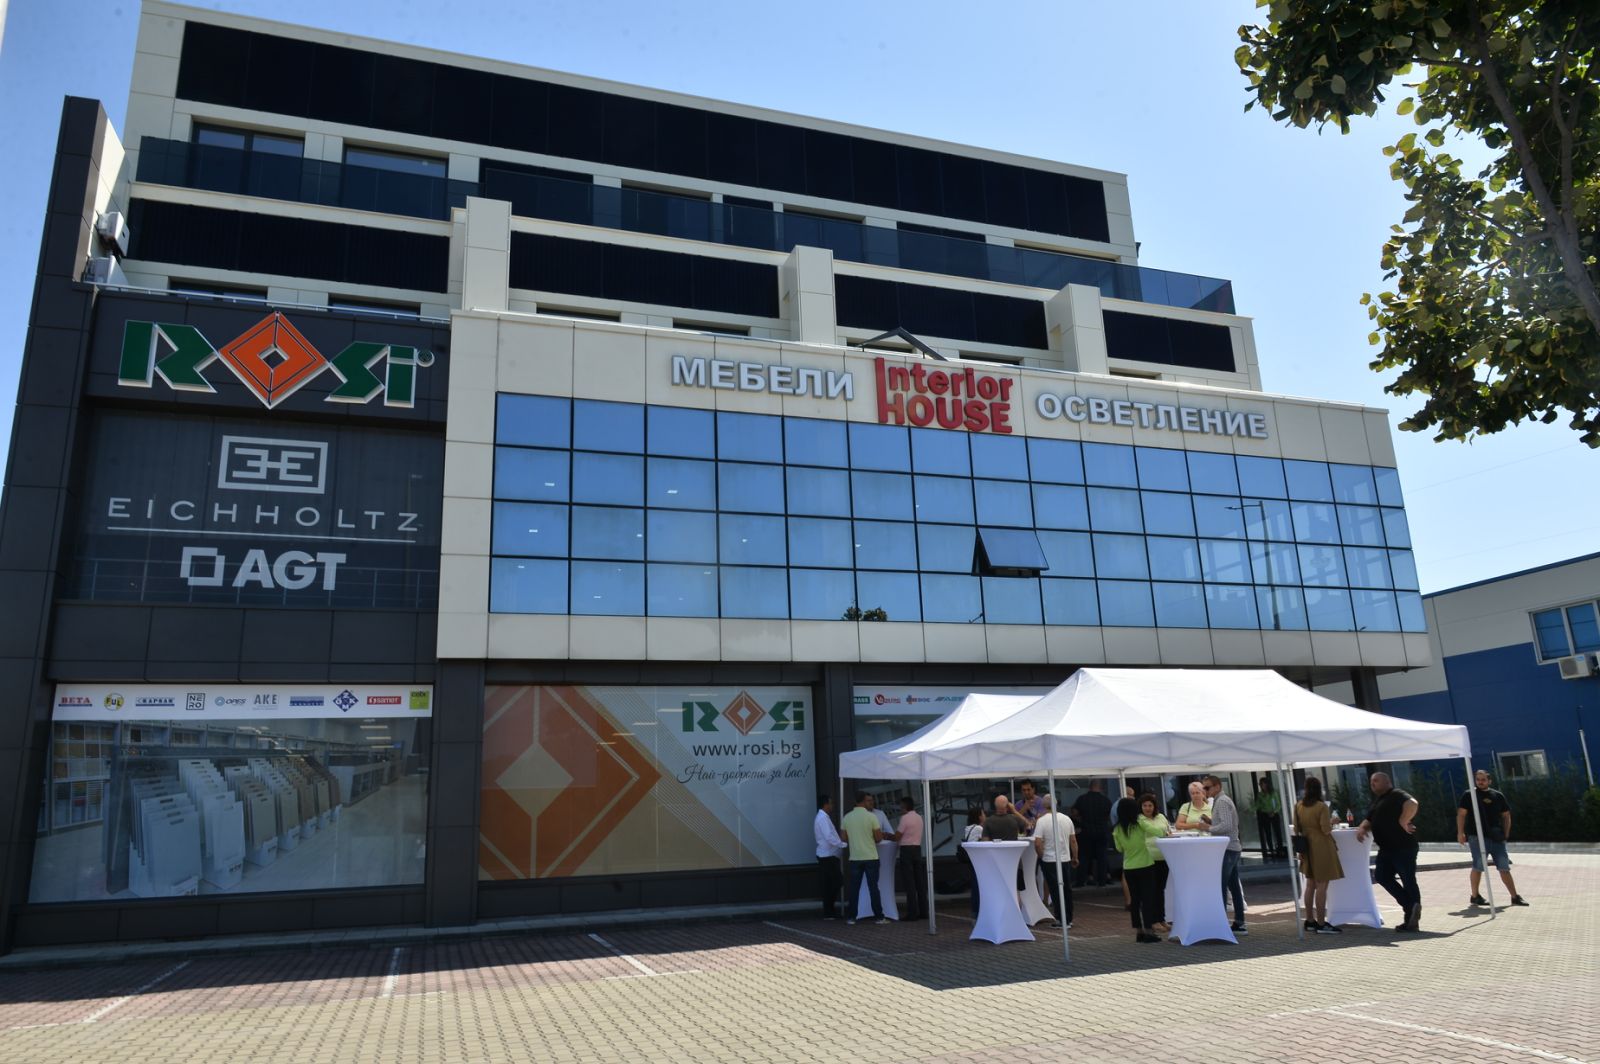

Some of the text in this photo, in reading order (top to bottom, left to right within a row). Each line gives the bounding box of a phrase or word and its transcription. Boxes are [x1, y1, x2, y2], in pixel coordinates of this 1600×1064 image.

[671, 356, 854, 401] МЕБЕЛИ
[874, 357, 1014, 401] Interior
[876, 392, 1013, 434] HOUSE
[1036, 392, 1268, 440] ОСВЕТЛЕНИЕ
[107, 496, 419, 533] EICHHOLTZ
[232, 548, 347, 591] AGT
[61, 696, 90, 704] BETA
[253, 694, 278, 704] AKE
[692, 740, 802, 759] www.rosi.bg
[768, 769, 782, 784] за
